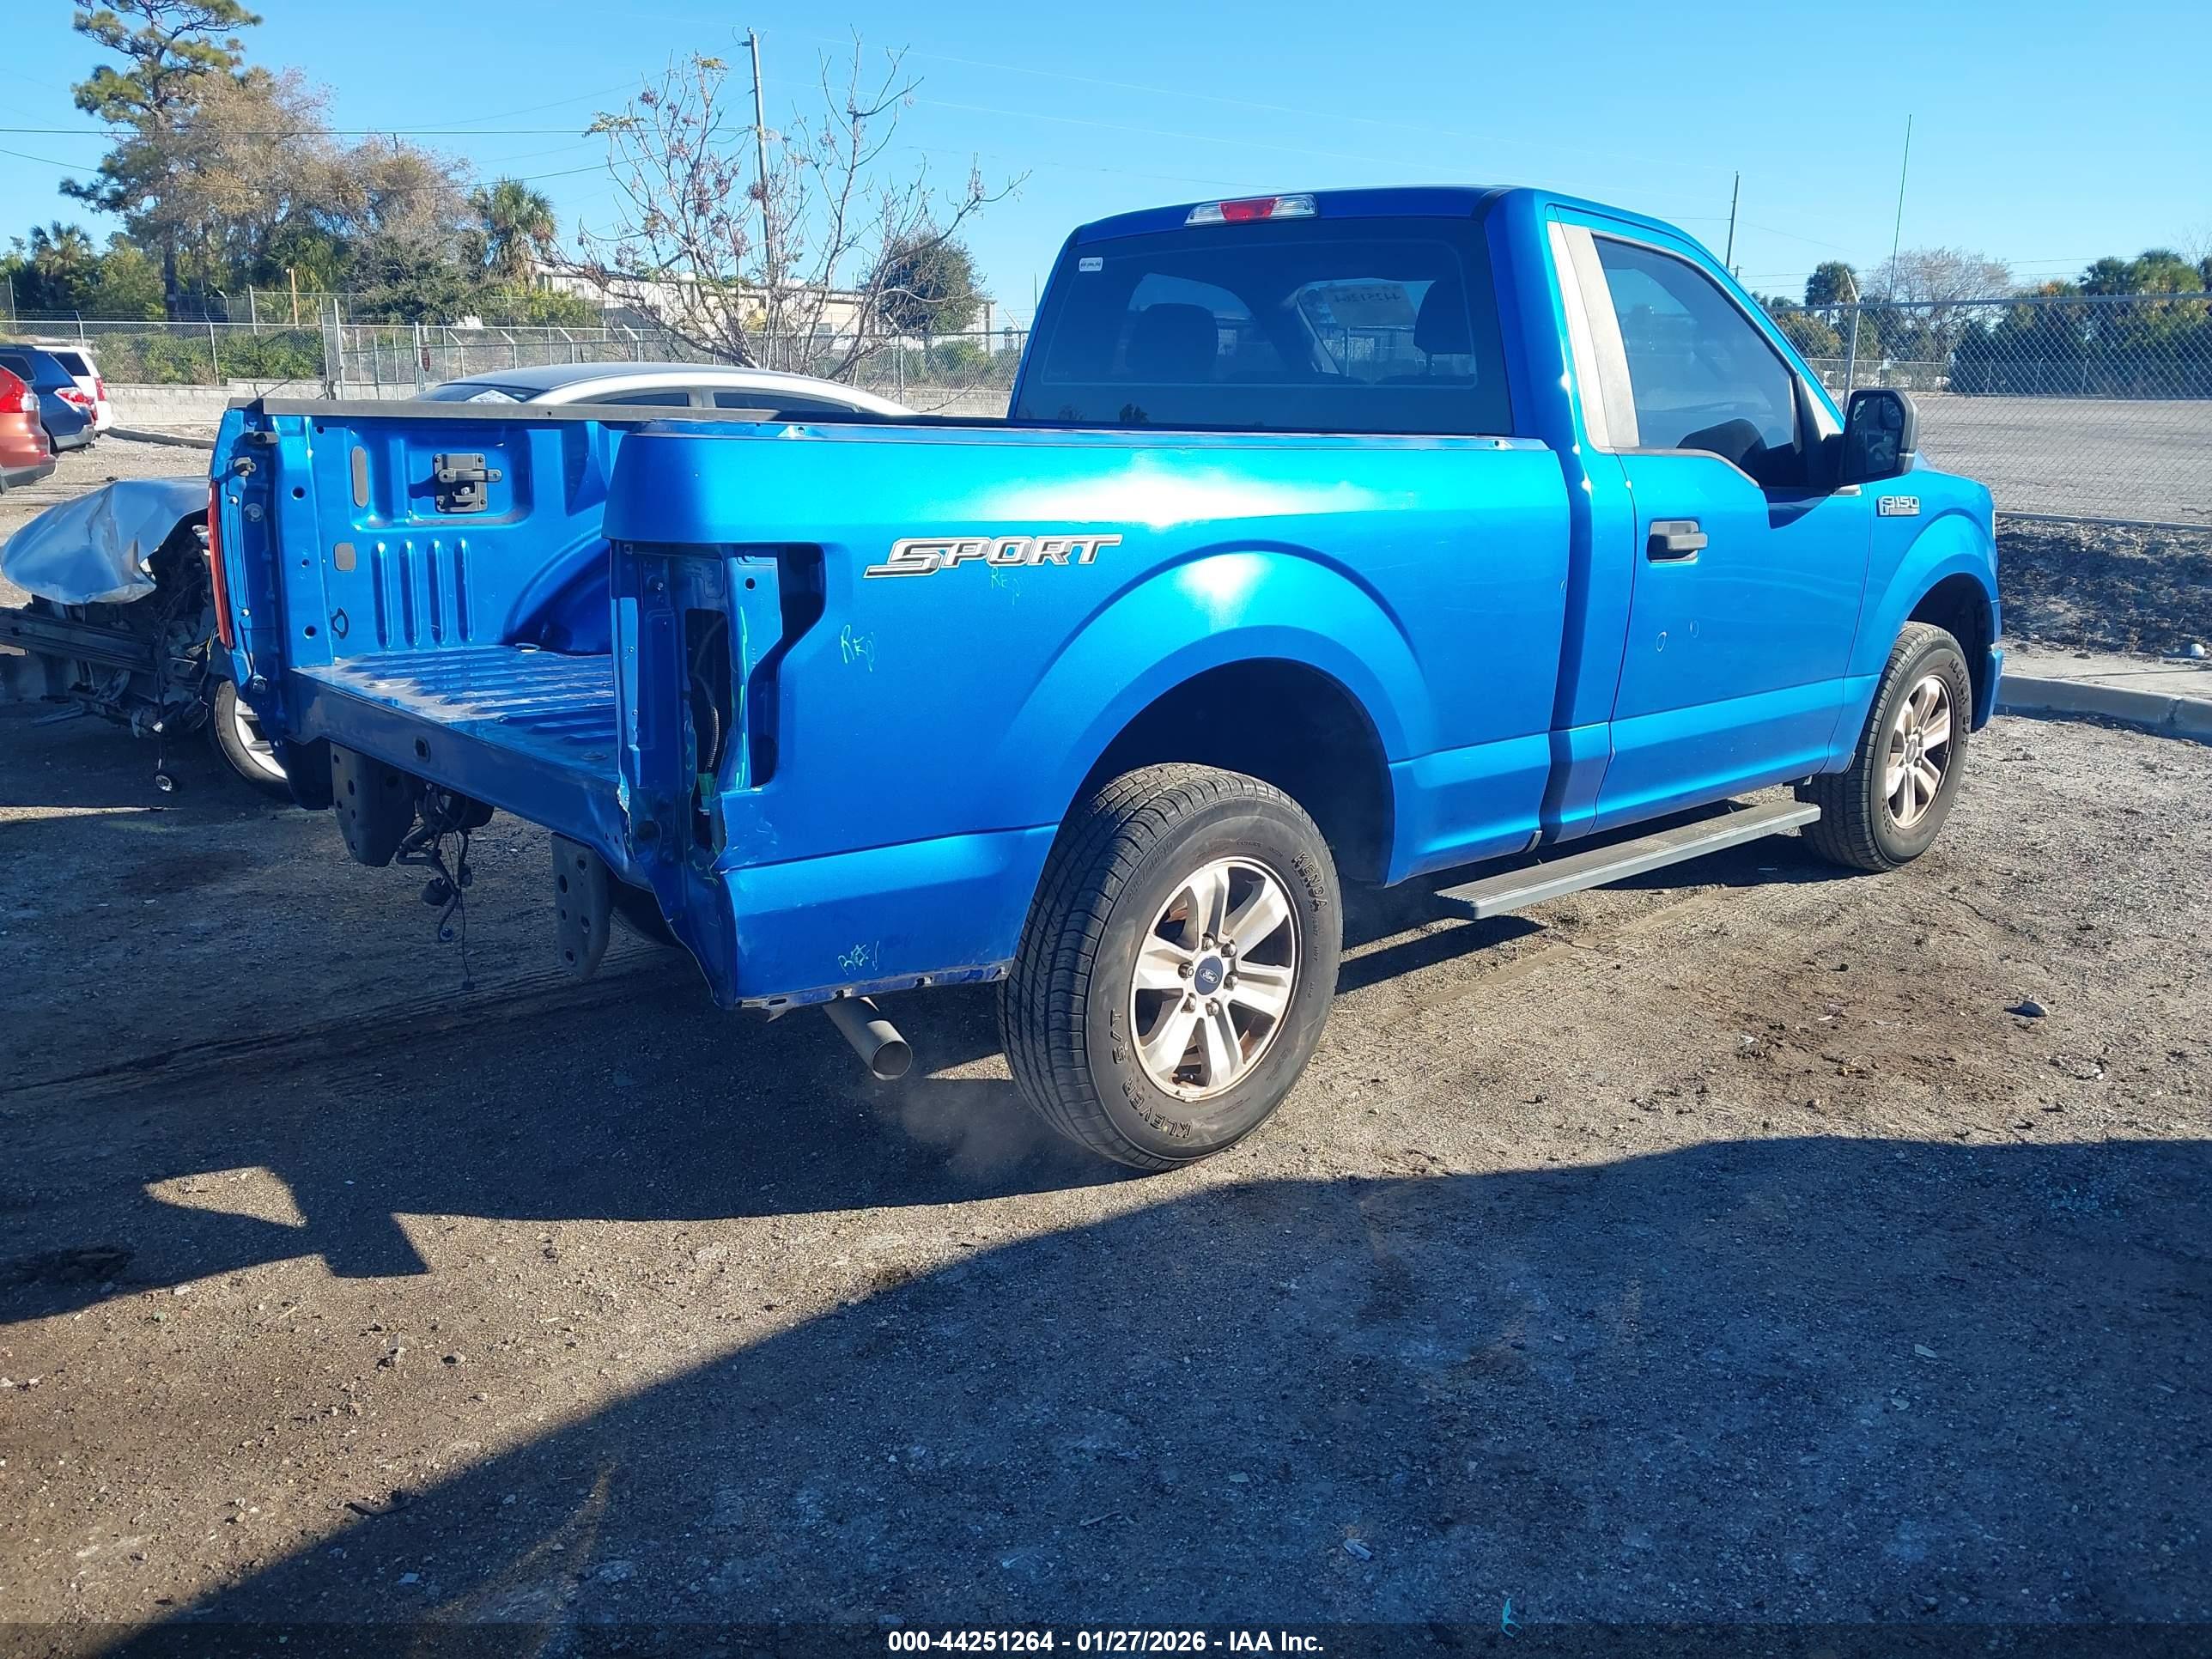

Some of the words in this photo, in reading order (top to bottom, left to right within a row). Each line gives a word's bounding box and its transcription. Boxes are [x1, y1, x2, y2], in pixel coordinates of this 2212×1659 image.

[864, 534, 1122, 578] SPORT
[1291, 850, 1328, 913] KENDA
[1110, 1008, 1126, 1064] S/T
[1122, 1079, 1192, 1138] KLEVER
